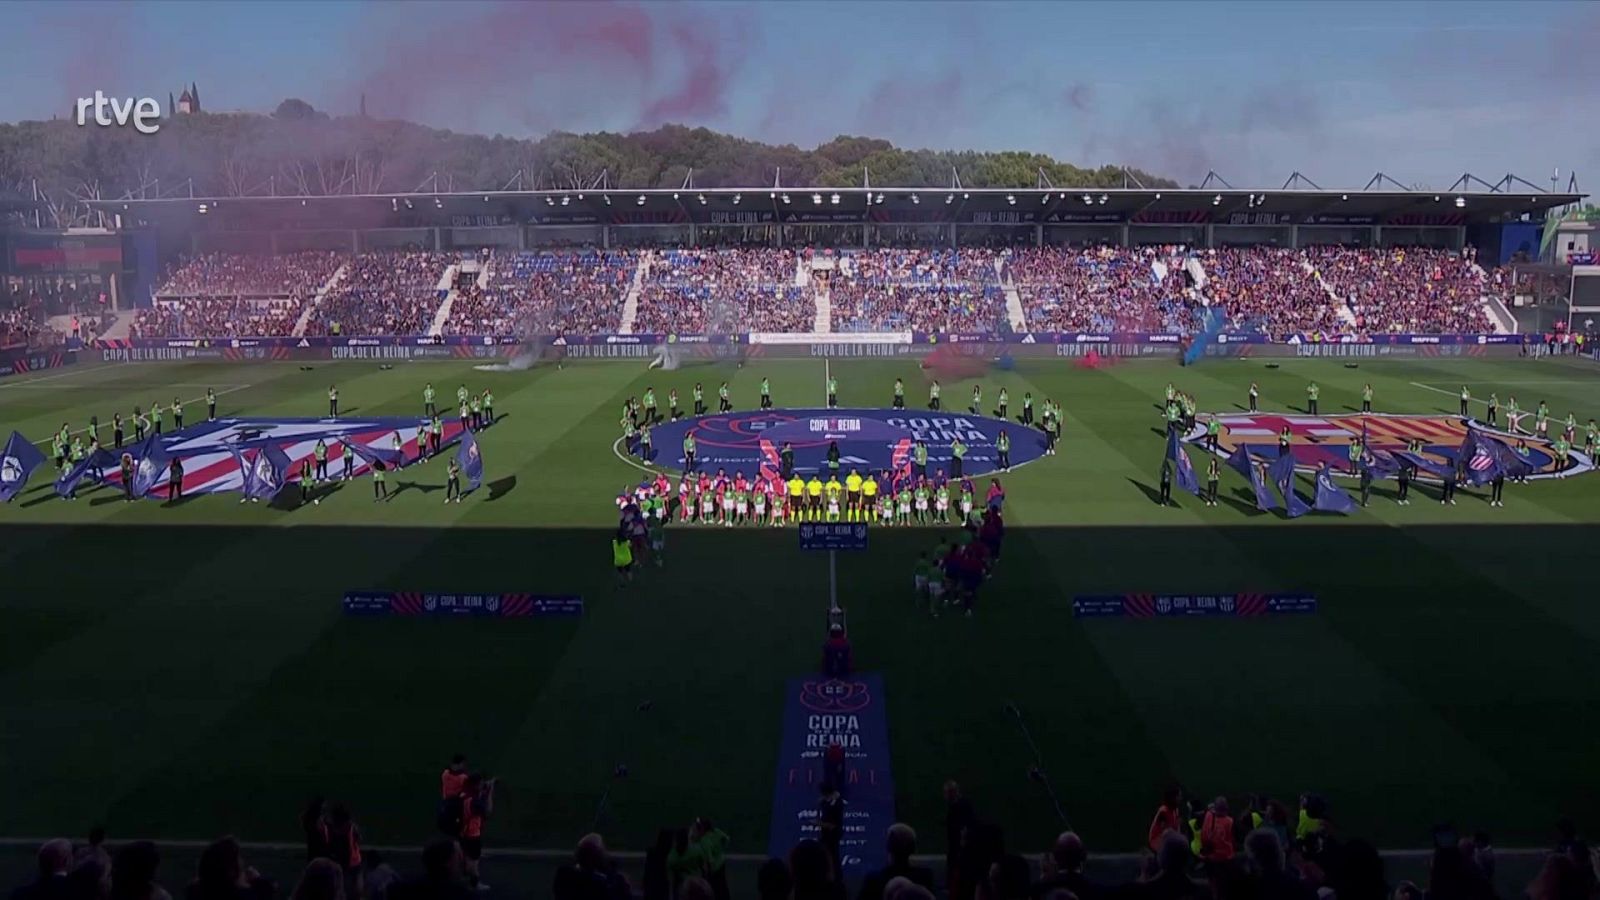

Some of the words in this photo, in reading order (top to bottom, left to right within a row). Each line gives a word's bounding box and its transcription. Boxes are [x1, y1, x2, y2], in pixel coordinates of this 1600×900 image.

[103, 348, 128, 361] COPA
[156, 348, 183, 361] REINA
[331, 346, 354, 359] COPA
[383, 346, 410, 359] REINA
[567, 345, 591, 357] COPA
[621, 345, 649, 357] REINA
[811, 344, 835, 356] COPA
[867, 344, 894, 356] REINA
[1057, 344, 1081, 356] COPA
[1112, 344, 1139, 356] REINA
[1297, 345, 1320, 356] COPA
[1350, 345, 1376, 356] REINA
[809, 418, 829, 431] COPA
[837, 418, 860, 431] REINA
[886, 416, 976, 430] COPA
[911, 430, 988, 441] EINA
[808, 714, 860, 730] COPA
[806, 734, 861, 748] REINA
[788, 768, 880, 785] FIAL
